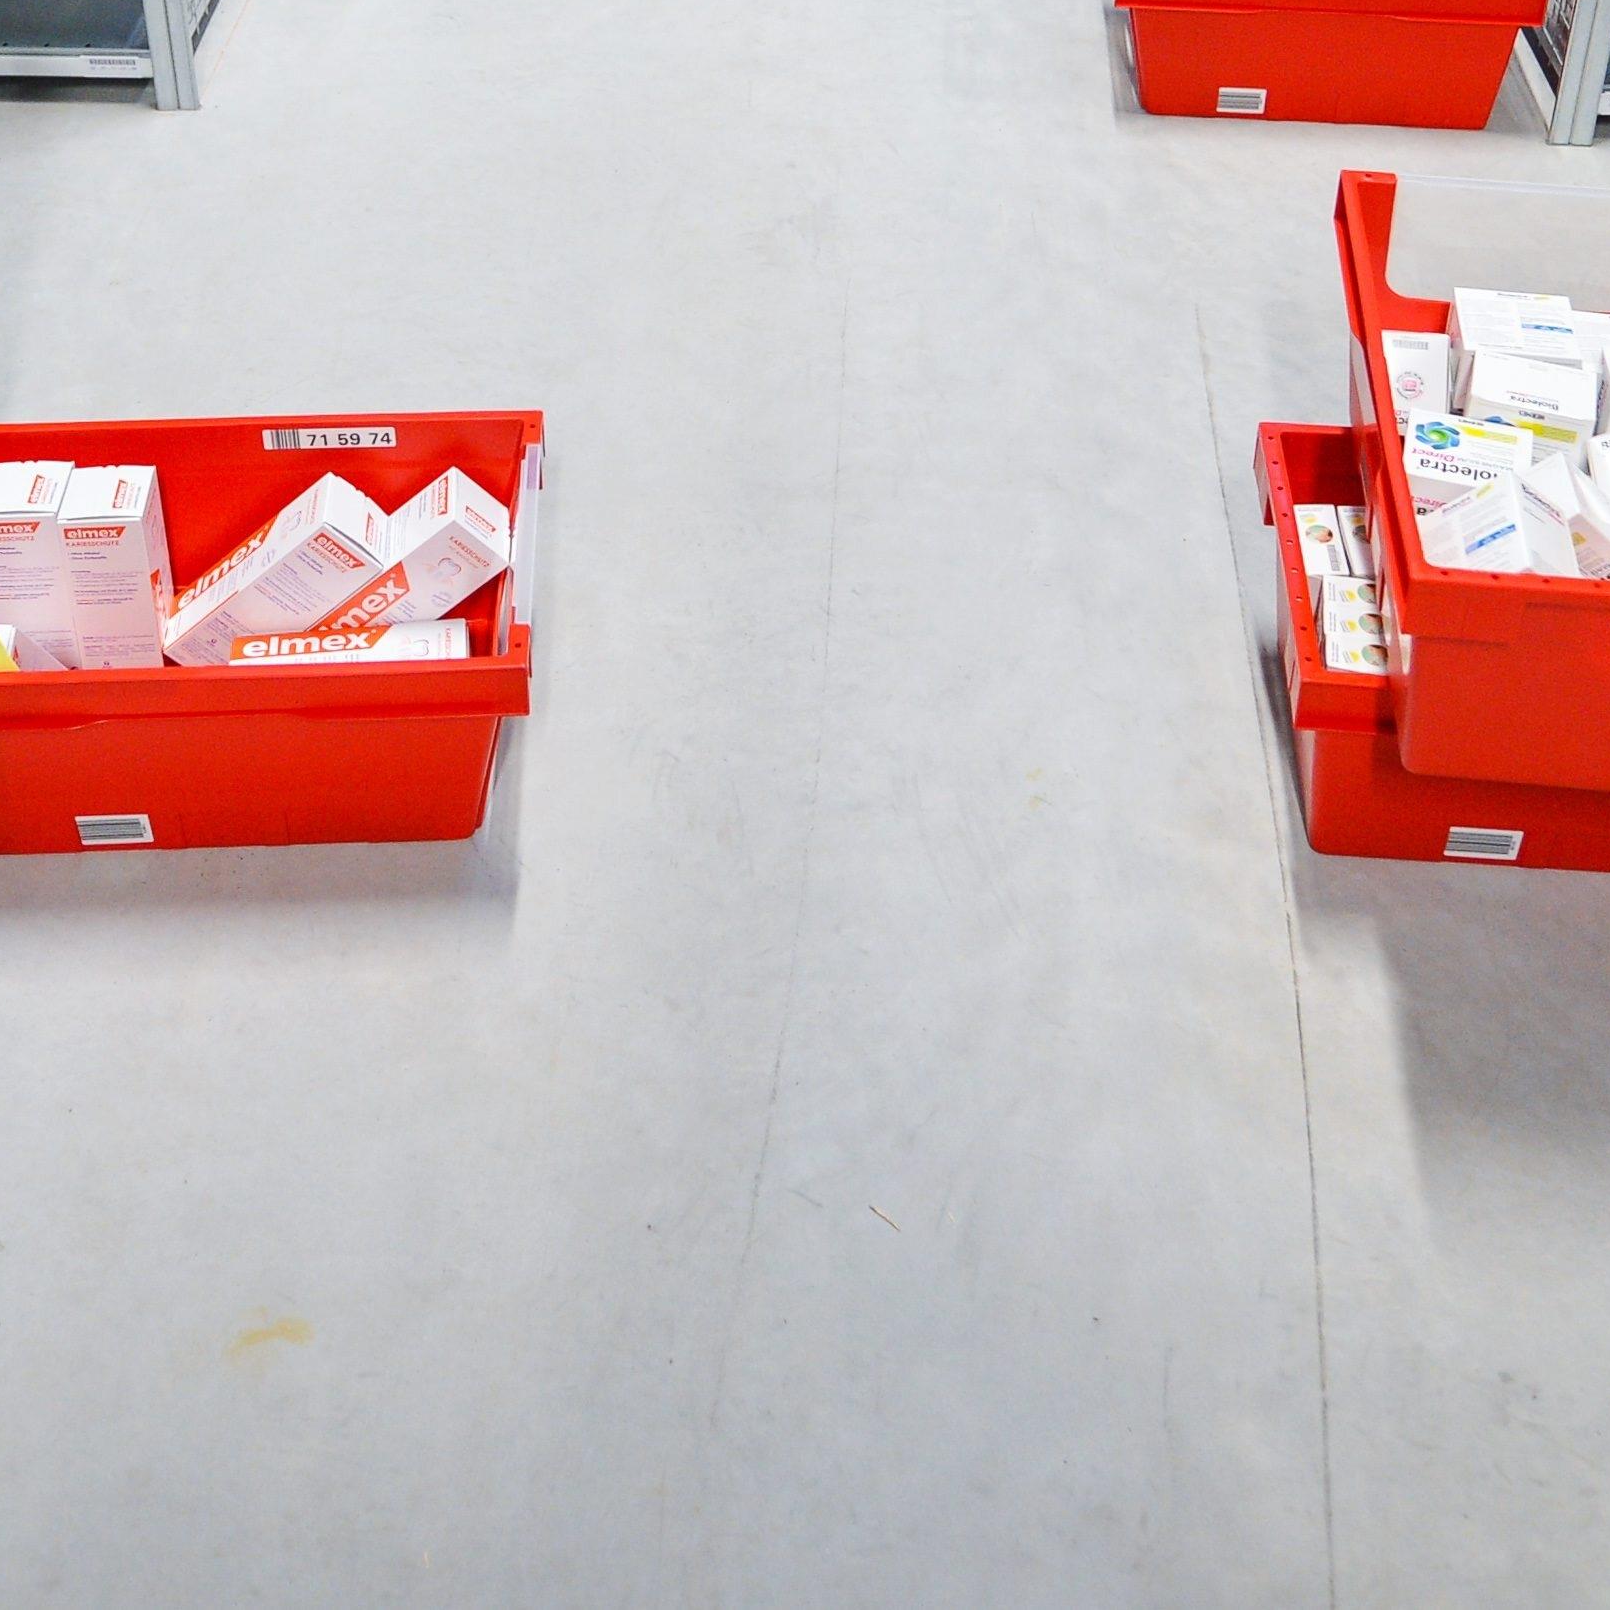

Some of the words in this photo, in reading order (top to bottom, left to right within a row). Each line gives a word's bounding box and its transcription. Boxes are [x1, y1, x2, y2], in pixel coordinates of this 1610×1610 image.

[306, 434, 328, 447] 71
[337, 433, 361, 446] 59
[368, 432, 393, 445] 74
[1410, 447, 1456, 463] Direct
[66, 527, 120, 540] elmex
[315, 534, 359, 569] elmex
[177, 531, 267, 610] elmex
[241, 630, 371, 658] elmex
